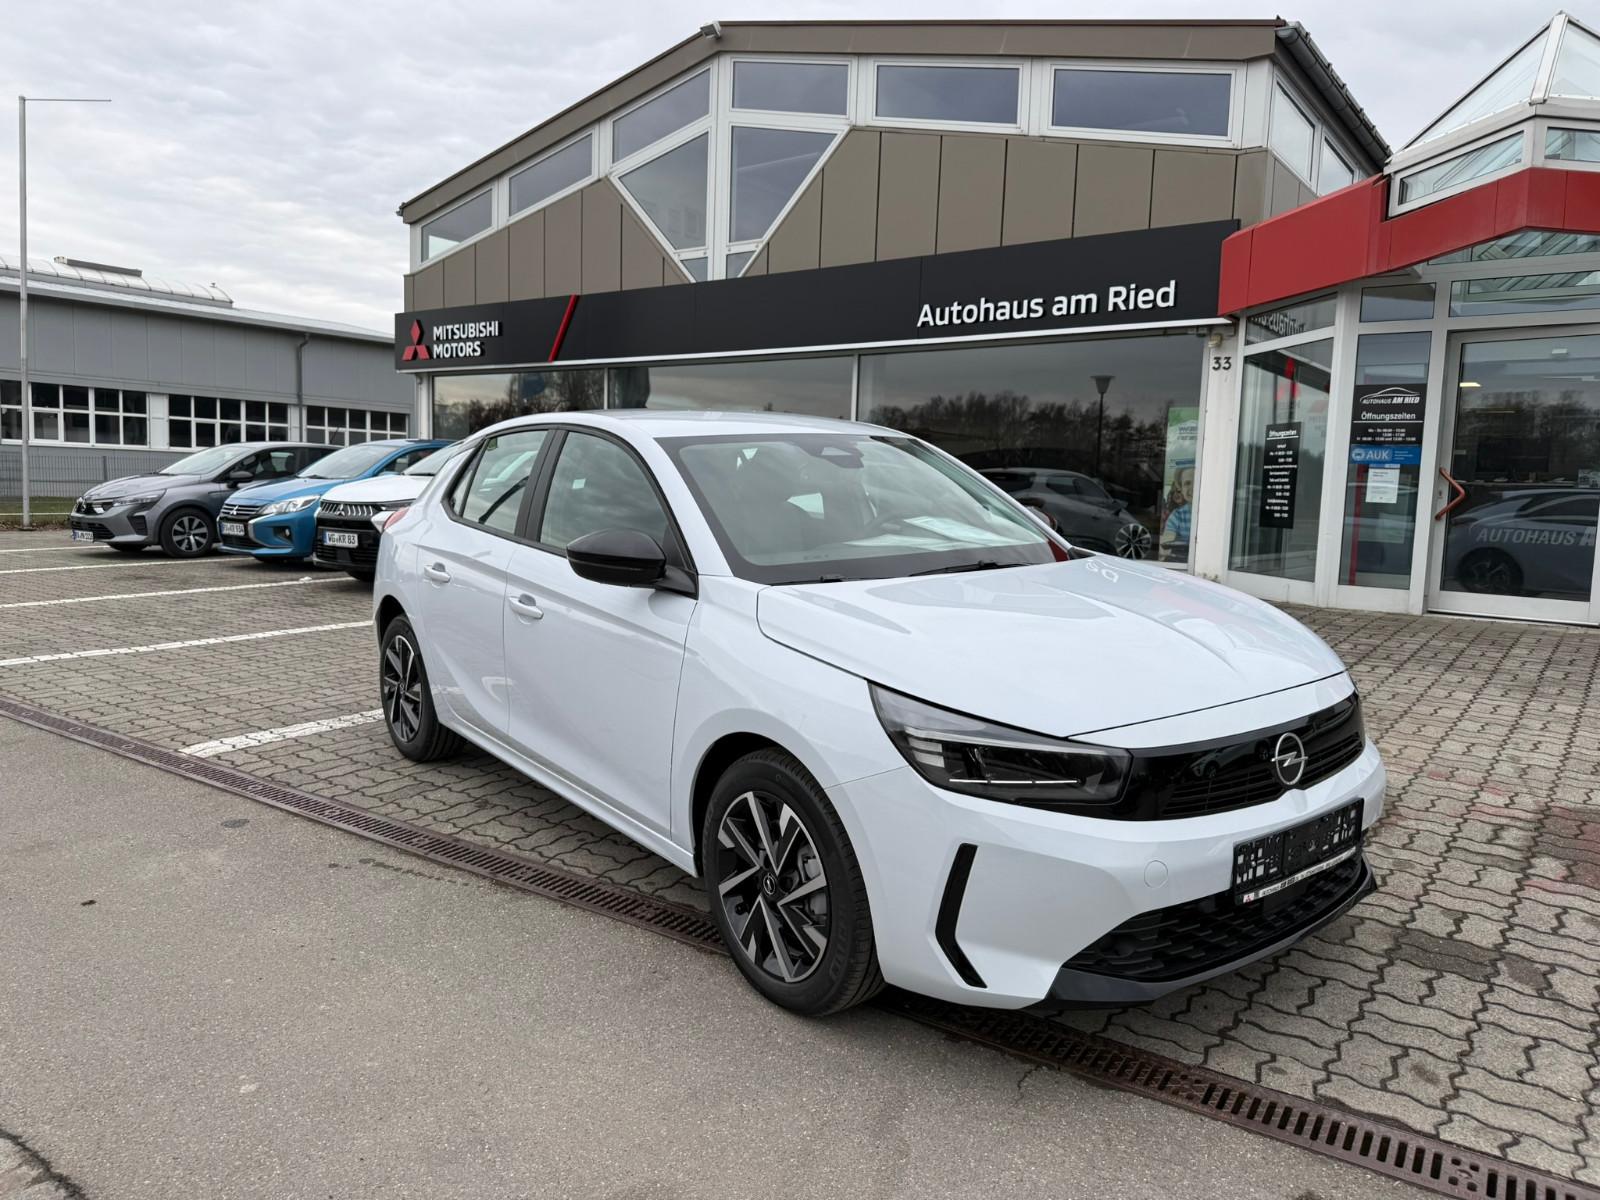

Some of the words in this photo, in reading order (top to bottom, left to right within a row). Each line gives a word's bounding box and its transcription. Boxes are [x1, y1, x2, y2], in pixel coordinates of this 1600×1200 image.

[917, 297, 1045, 327] Autohaus
[1051, 293, 1099, 316] am
[1107, 279, 1177, 312] Ried
[433, 320, 499, 340] MITSUBISHI
[433, 341, 482, 359] MOTORS
[1212, 356, 1232, 371] 33
[1391, 396, 1404, 404] AM
[1404, 396, 1420, 404] RIED
[1361, 410, 1416, 421] Öffnungszeiten
[1366, 448, 1390, 460] AUK
[1476, 528, 1577, 545] AUTOHAUS
